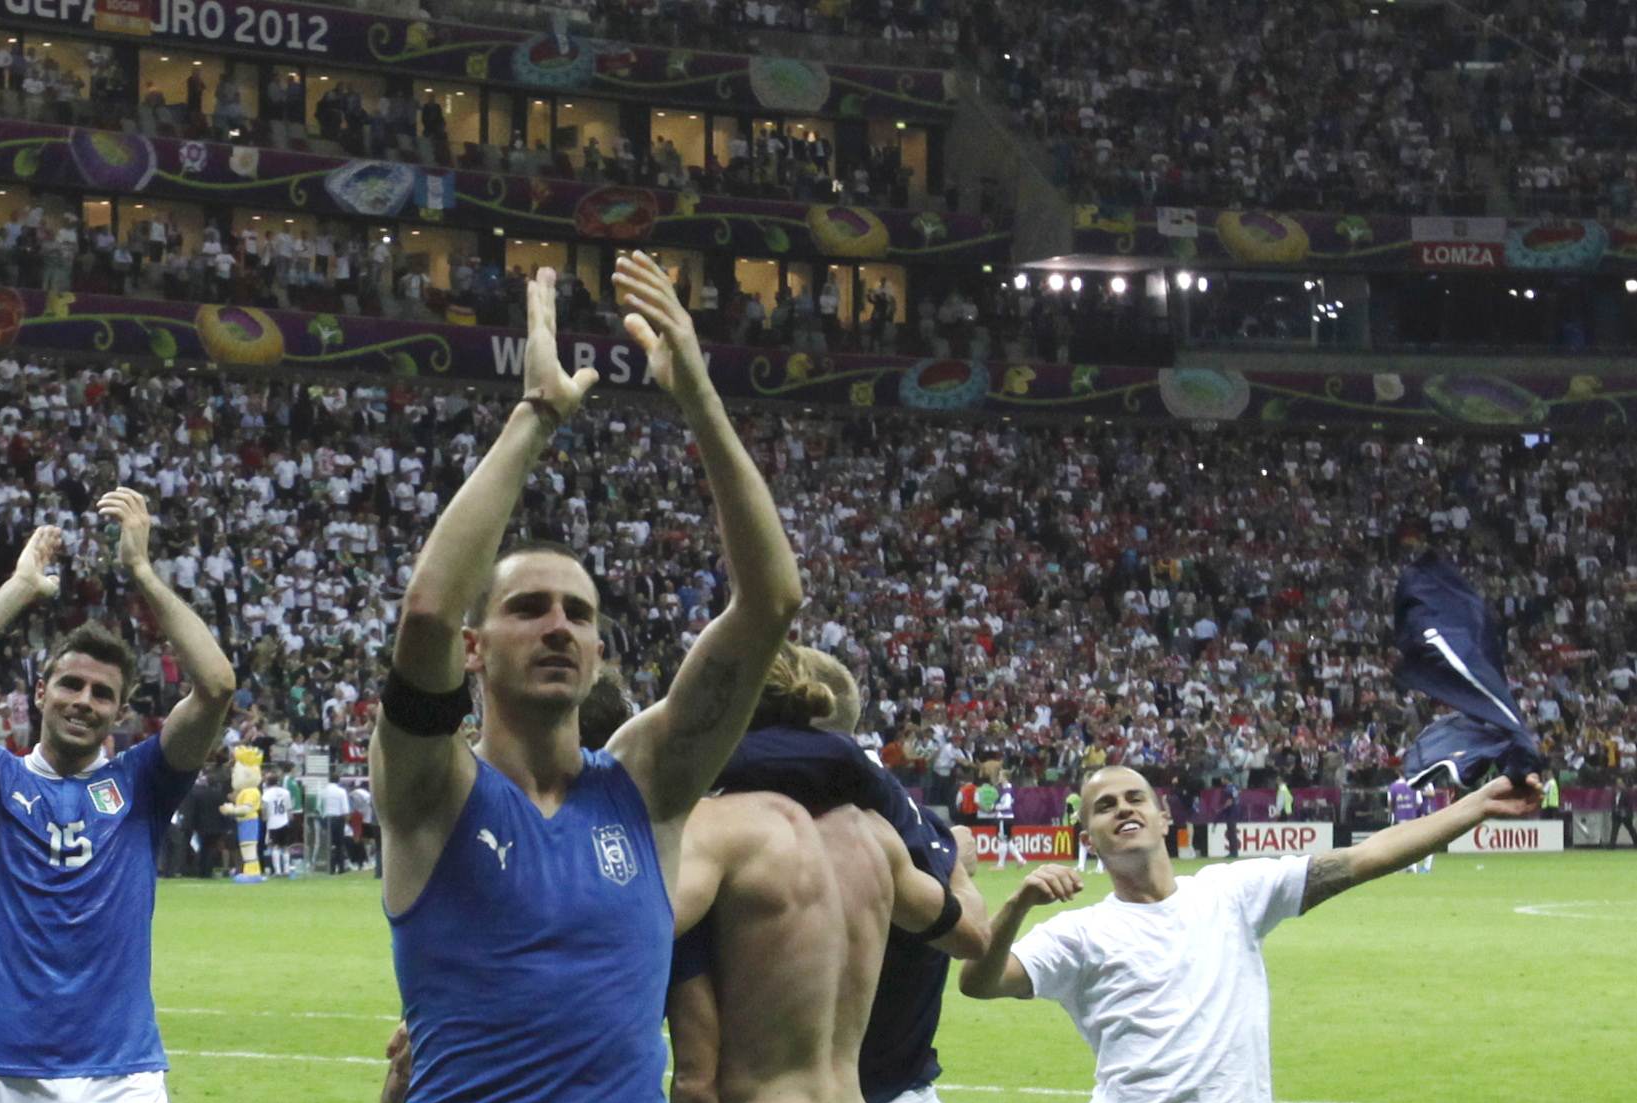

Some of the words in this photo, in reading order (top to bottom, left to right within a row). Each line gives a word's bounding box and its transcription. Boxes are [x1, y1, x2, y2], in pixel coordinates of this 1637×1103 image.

[234, 7, 329, 52] 2012
[46, 820, 93, 867] 15
[1225, 827, 1317, 851] SHARP
[1473, 824, 1539, 850] Canon
